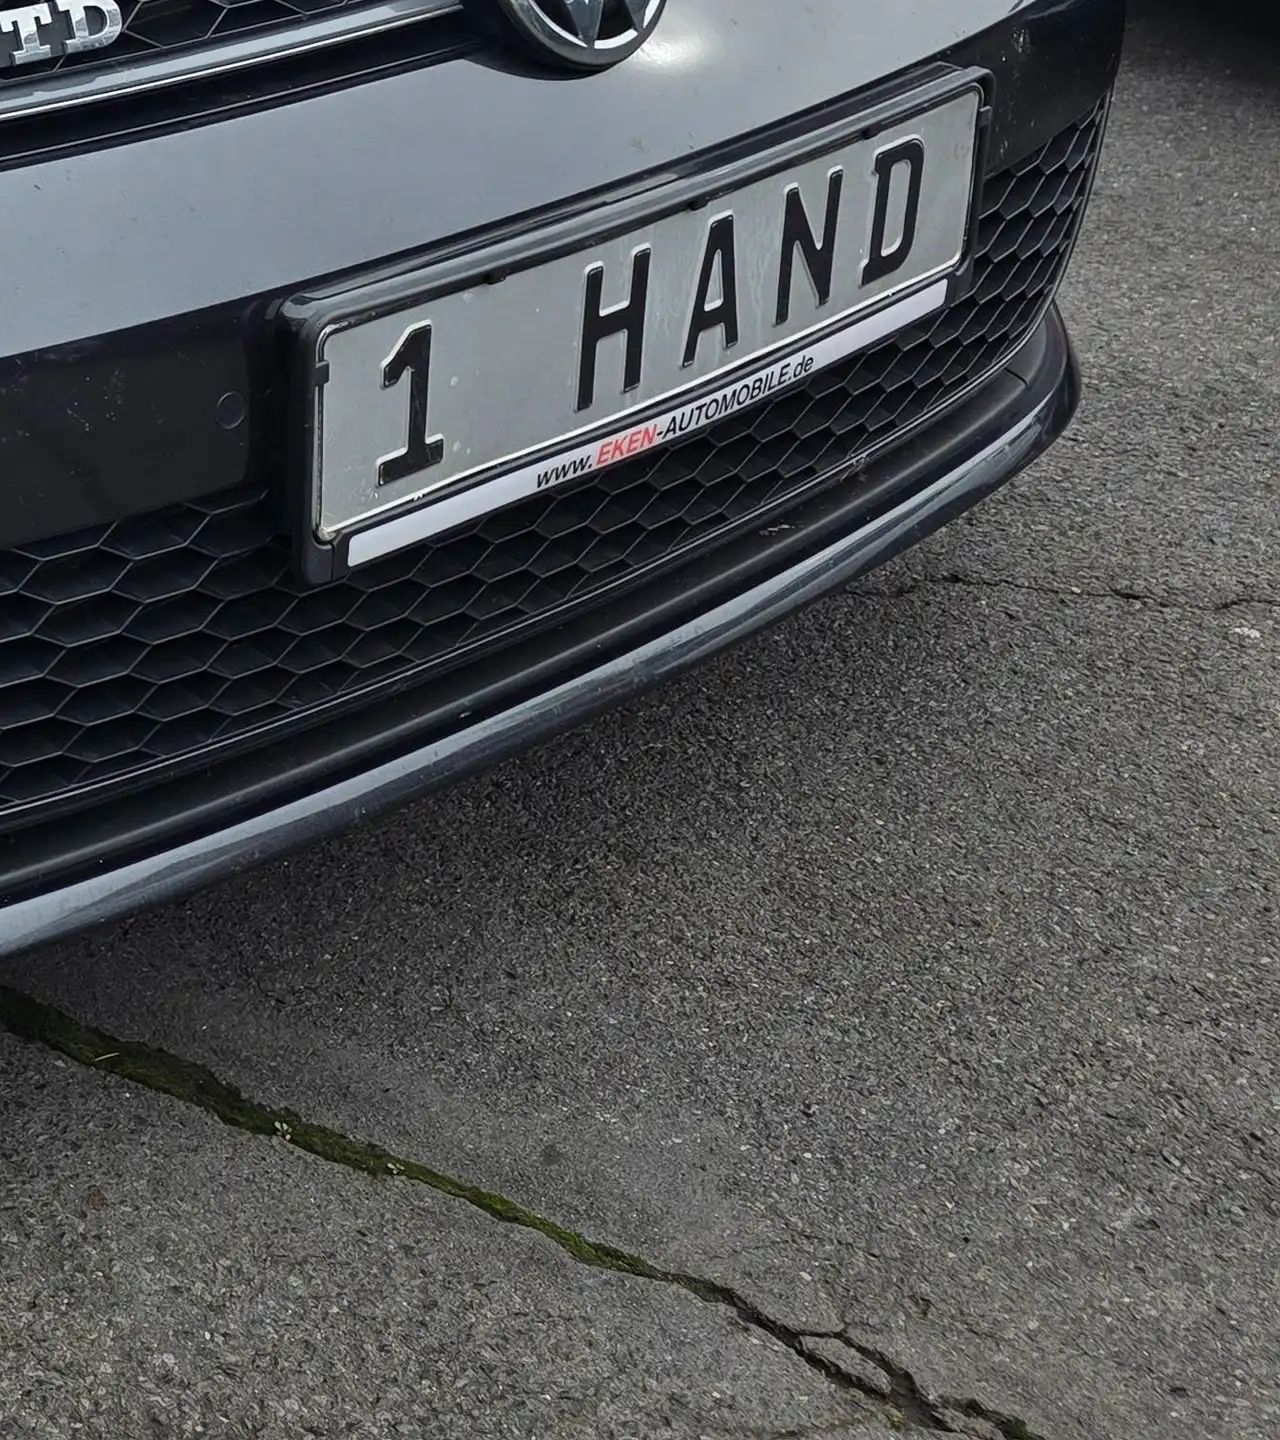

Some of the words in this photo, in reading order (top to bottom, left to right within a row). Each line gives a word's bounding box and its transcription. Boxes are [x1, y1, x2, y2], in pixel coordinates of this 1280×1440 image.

[375, 318, 445, 486] 1
[573, 134, 925, 412] HAND
[535, 354, 815, 489] www.EKEN-AUTOMOBILE.de
